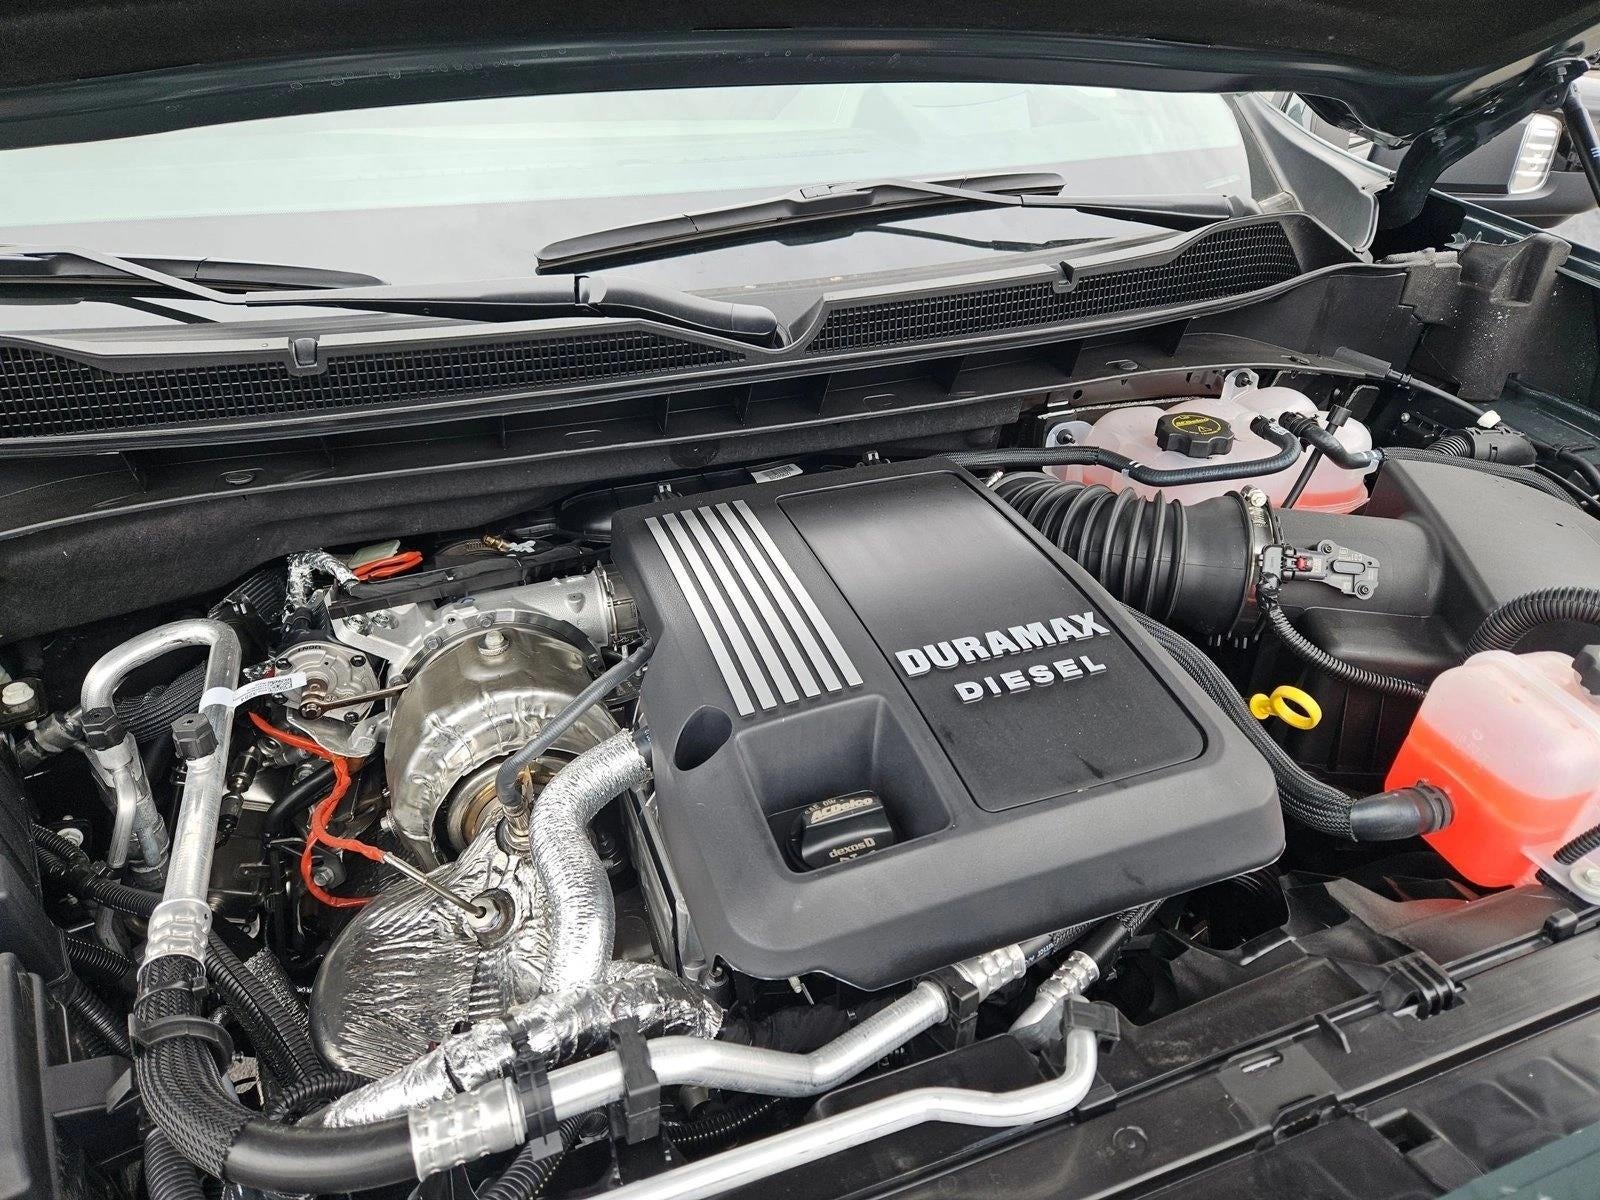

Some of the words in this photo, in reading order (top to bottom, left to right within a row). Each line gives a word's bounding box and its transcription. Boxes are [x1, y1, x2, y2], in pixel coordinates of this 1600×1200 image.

[895, 611, 1111, 677] DURAMAX
[954, 655, 1107, 704] DIESEL
[811, 797, 874, 824] ACDelco
